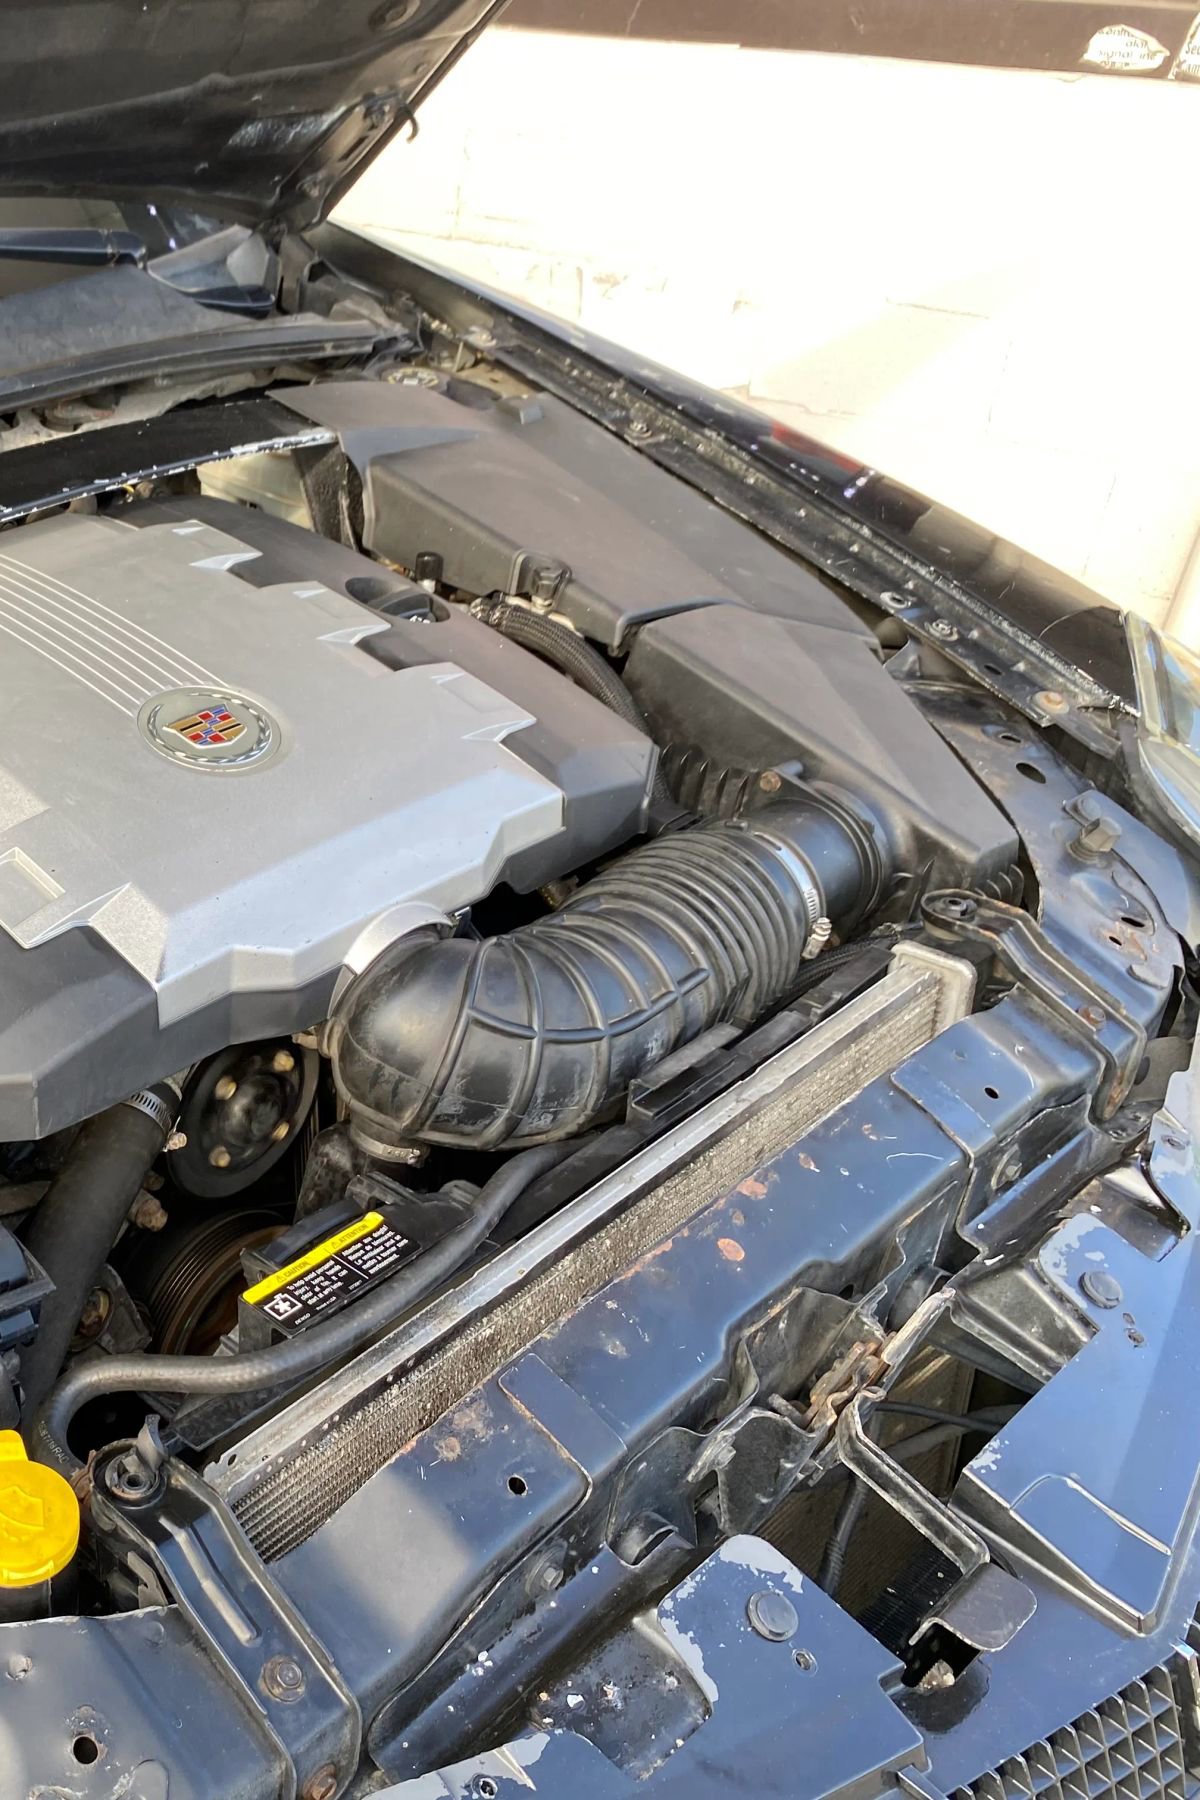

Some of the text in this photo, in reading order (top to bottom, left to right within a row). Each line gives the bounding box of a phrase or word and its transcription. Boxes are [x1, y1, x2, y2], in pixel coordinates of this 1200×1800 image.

[339, 1224, 368, 1243] ATTENTION
[284, 1261, 309, 1277] CAUTION
[303, 1272, 317, 1281] avoid
[315, 1260, 335, 1274] personal
[310, 1276, 324, 1285] keep
[325, 1265, 341, 1275] hands
[301, 1291, 313, 1300] clear
[338, 1269, 348, 1277] can
[307, 1296, 319, 1304] start
[323, 1287, 332, 1295] any
